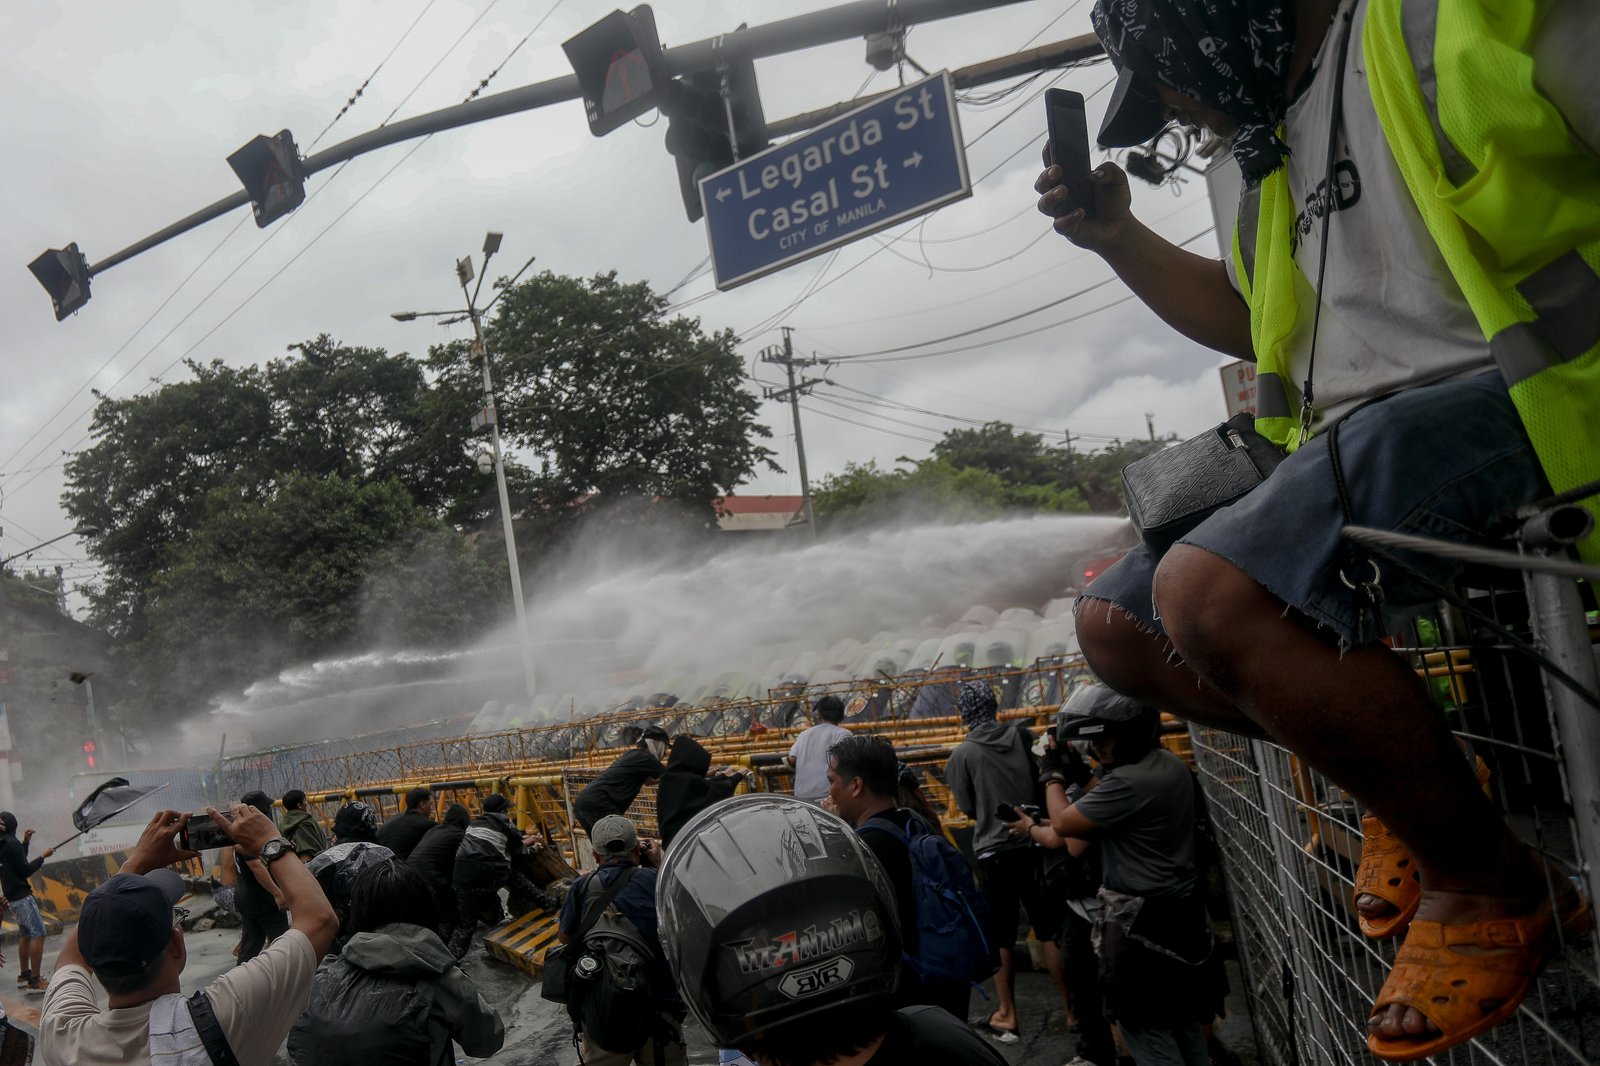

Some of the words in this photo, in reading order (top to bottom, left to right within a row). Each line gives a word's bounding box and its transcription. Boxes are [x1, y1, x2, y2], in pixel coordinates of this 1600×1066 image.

[738, 119, 882, 200] Legarda
[894, 87, 935, 130] St
[748, 177, 839, 240] Casal
[851, 157, 889, 198] St
[780, 229, 807, 250] CITY
[814, 220, 829, 236] OF
[837, 199, 886, 227] MANILA
